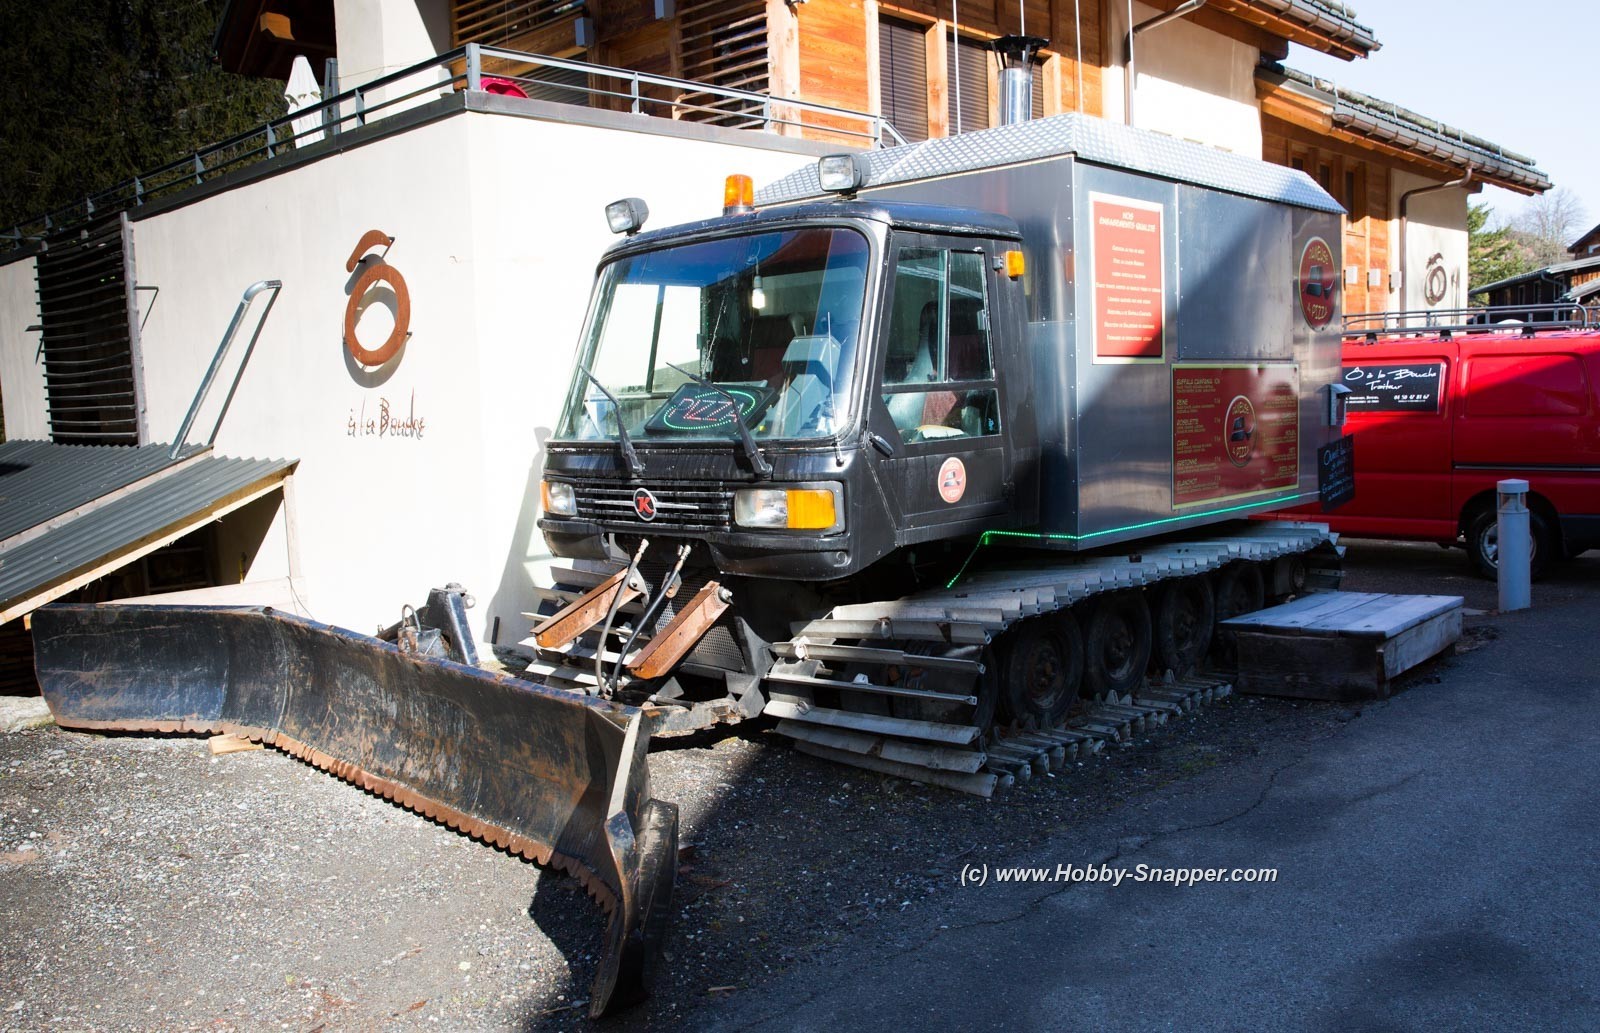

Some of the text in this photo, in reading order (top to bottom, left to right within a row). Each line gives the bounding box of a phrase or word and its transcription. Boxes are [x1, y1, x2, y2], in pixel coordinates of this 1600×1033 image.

[1122, 211, 1134, 221] NOS
[1387, 367, 1437, 380] Bouche
[1365, 380, 1403, 391] Traiteur
[667, 397, 744, 423] PIZZA
[637, 496, 655, 514] K
